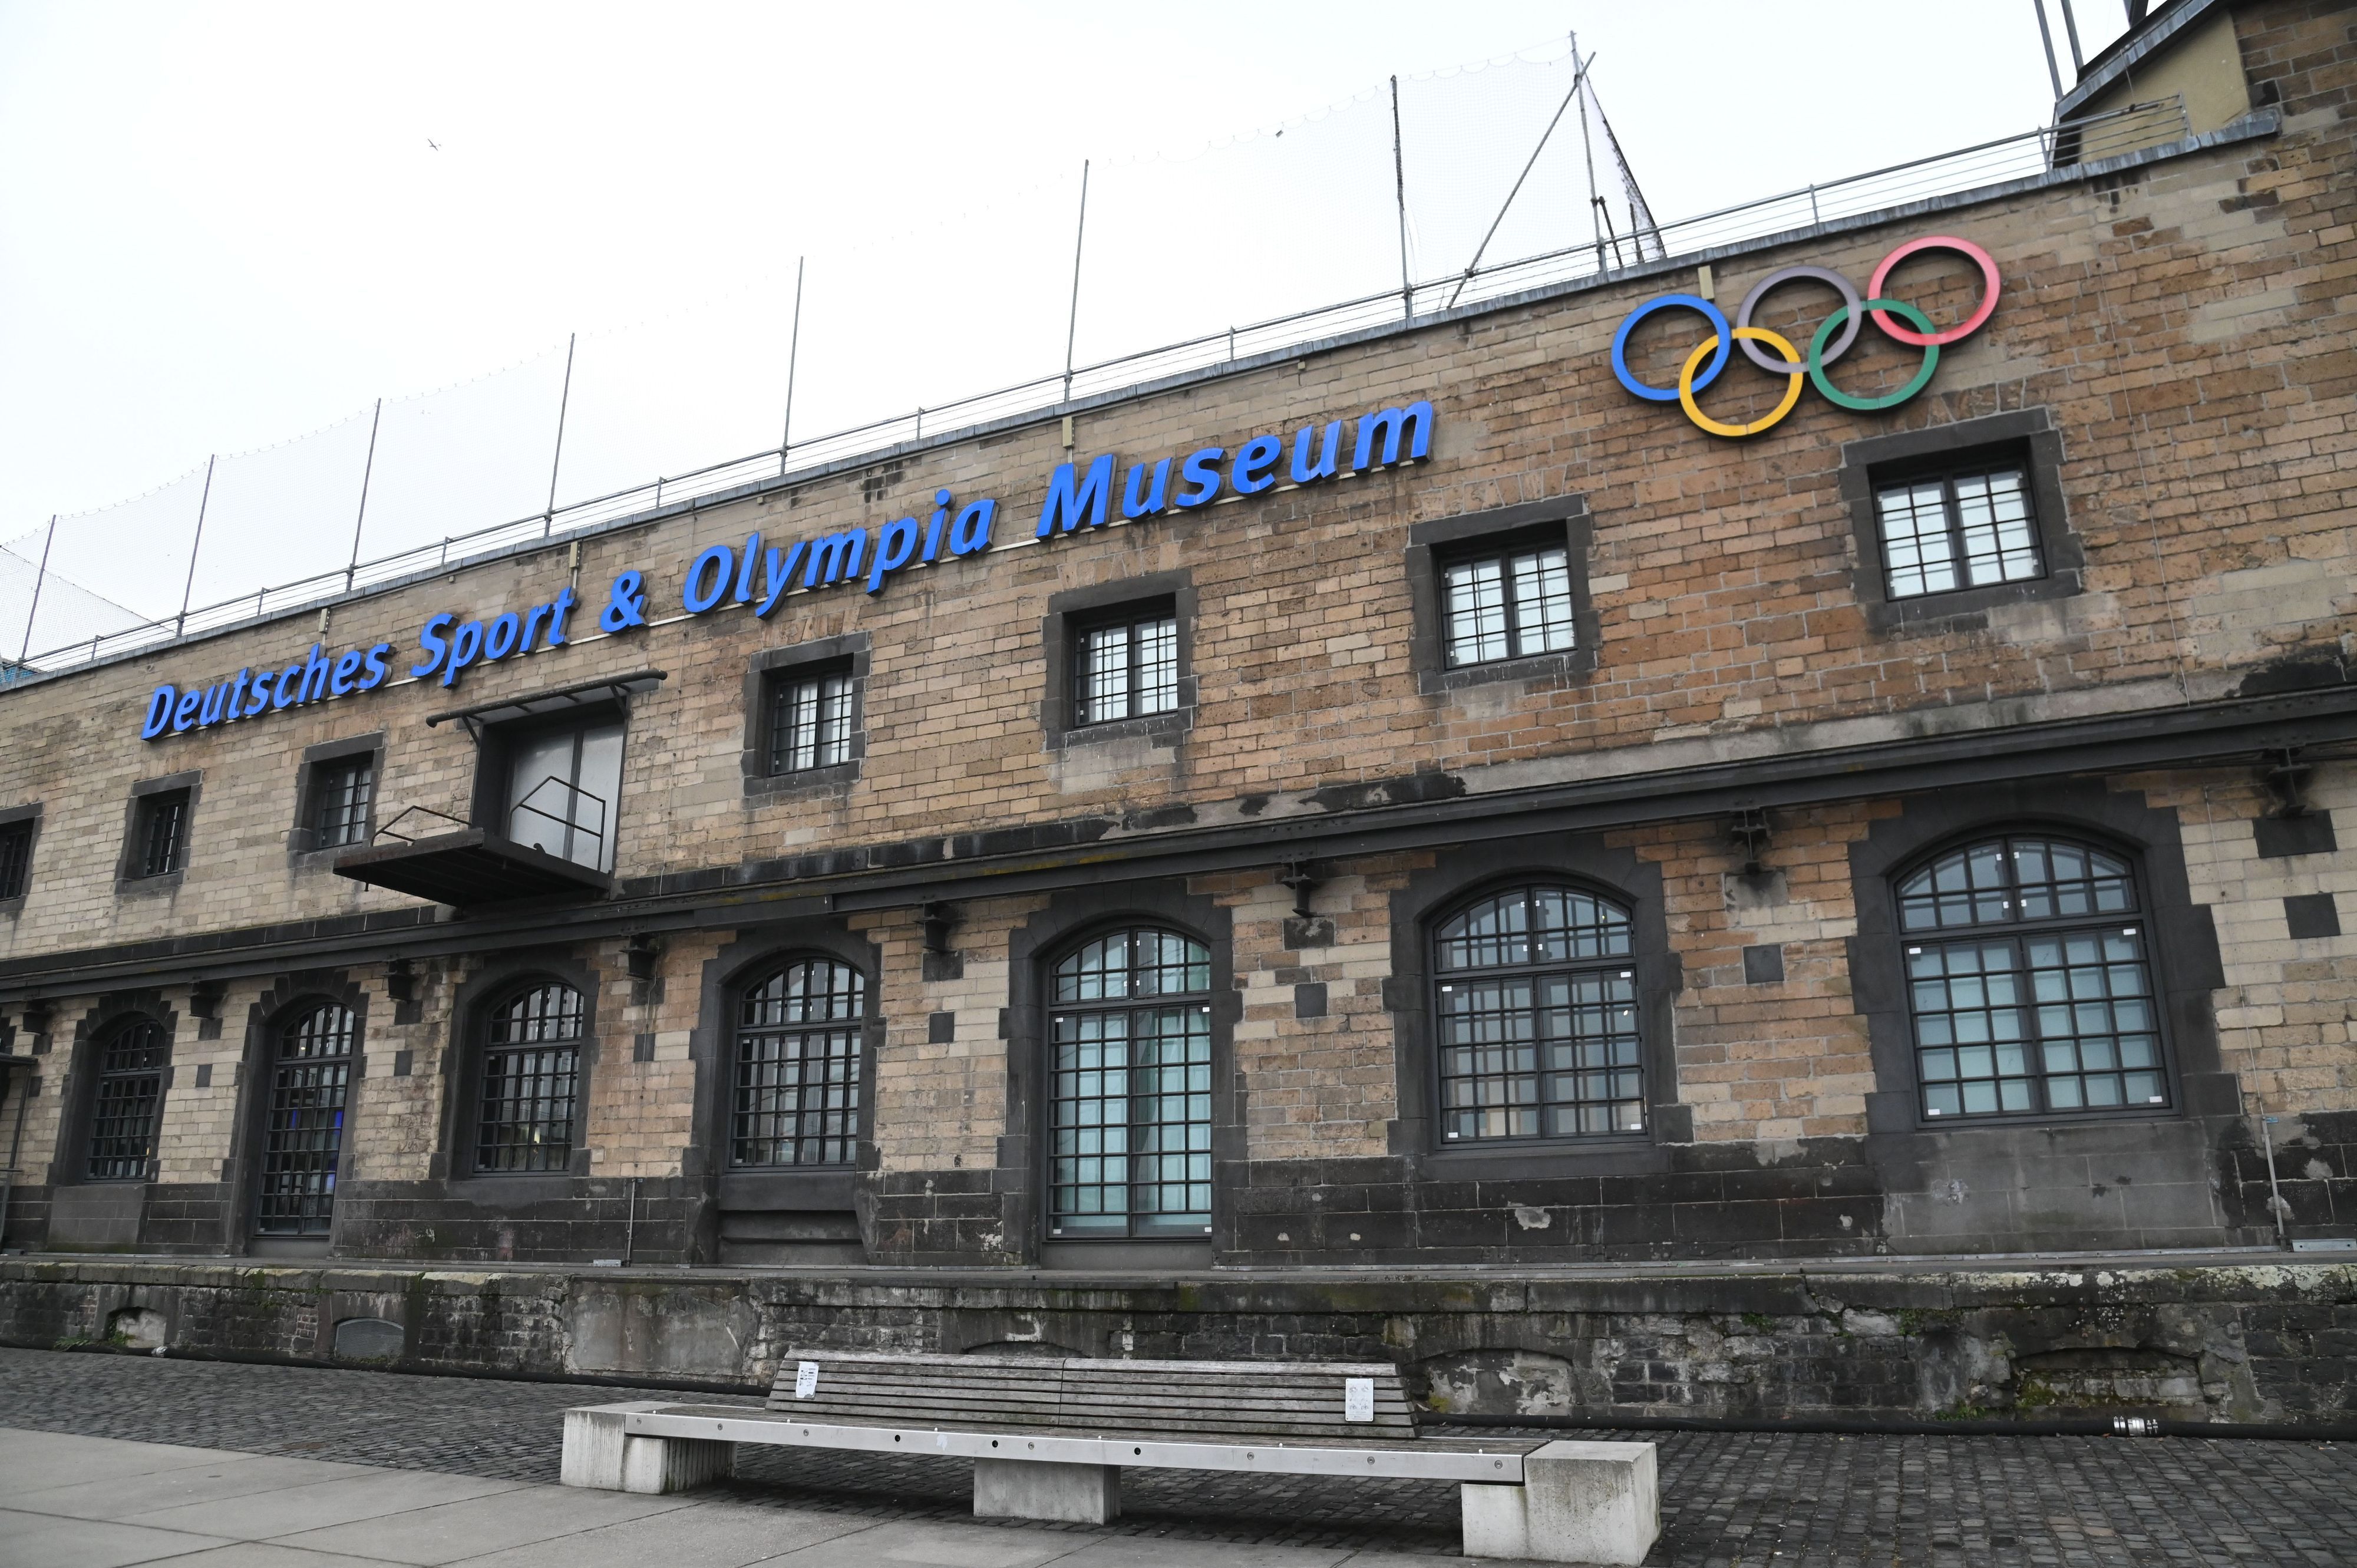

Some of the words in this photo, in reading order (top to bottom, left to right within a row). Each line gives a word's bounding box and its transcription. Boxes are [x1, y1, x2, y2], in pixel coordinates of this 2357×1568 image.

[141, 643, 393, 741] Deutsches
[411, 587, 577, 688] Sport
[600, 570, 646, 633] &
[683, 489, 997, 618] Olympia
[1035, 401, 1434, 540] Museum
